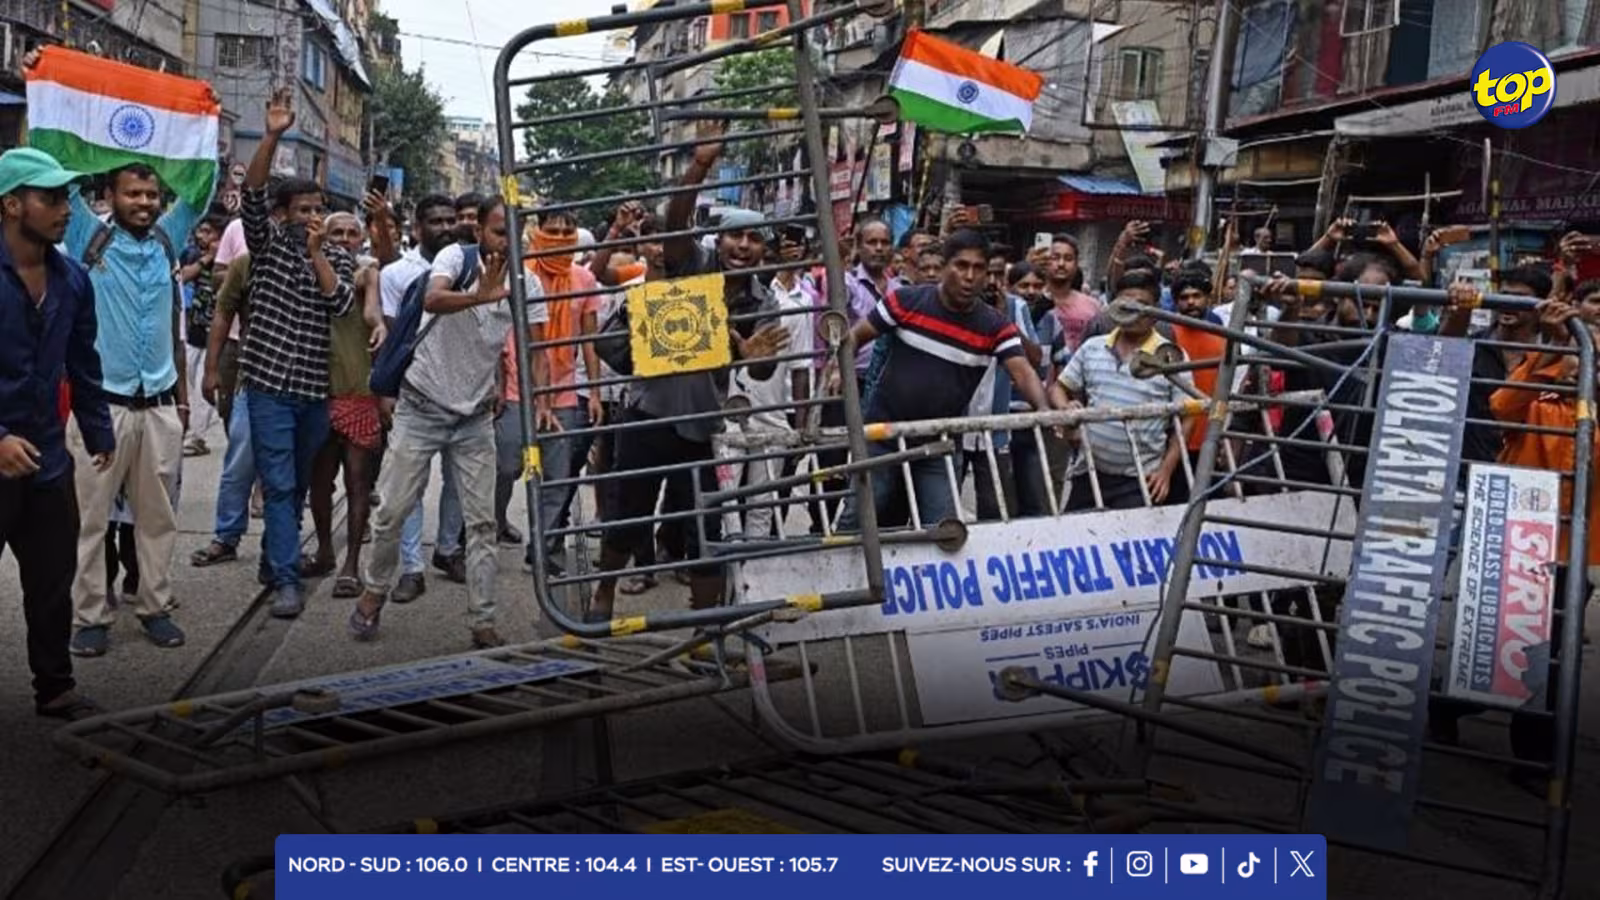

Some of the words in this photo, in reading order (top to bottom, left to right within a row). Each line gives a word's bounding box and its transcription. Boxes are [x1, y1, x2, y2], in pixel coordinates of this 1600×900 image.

[1455, 198, 1532, 216] AGAWAL
[1370, 371, 1459, 503] KOLKATA
[1473, 473, 1486, 501] THE
[1468, 507, 1484, 575] SCIENCE
[986, 545, 1114, 604] TRAFFIC
[1346, 516, 1440, 650] TRAFFIC
[1465, 577, 1479, 601] OF
[1026, 620, 1083, 638] SAFEST
[1087, 613, 1141, 631] INDIA'S
[1501, 524, 1549, 681] SERVO
[980, 626, 1022, 642] PIPES
[1043, 643, 1089, 660] PIPES
[1456, 605, 1475, 690] EXTREME
[1473, 585, 1499, 690] LUBRICANTS
[987, 650, 1151, 702] SKIPP
[1324, 652, 1419, 794] POLICE
